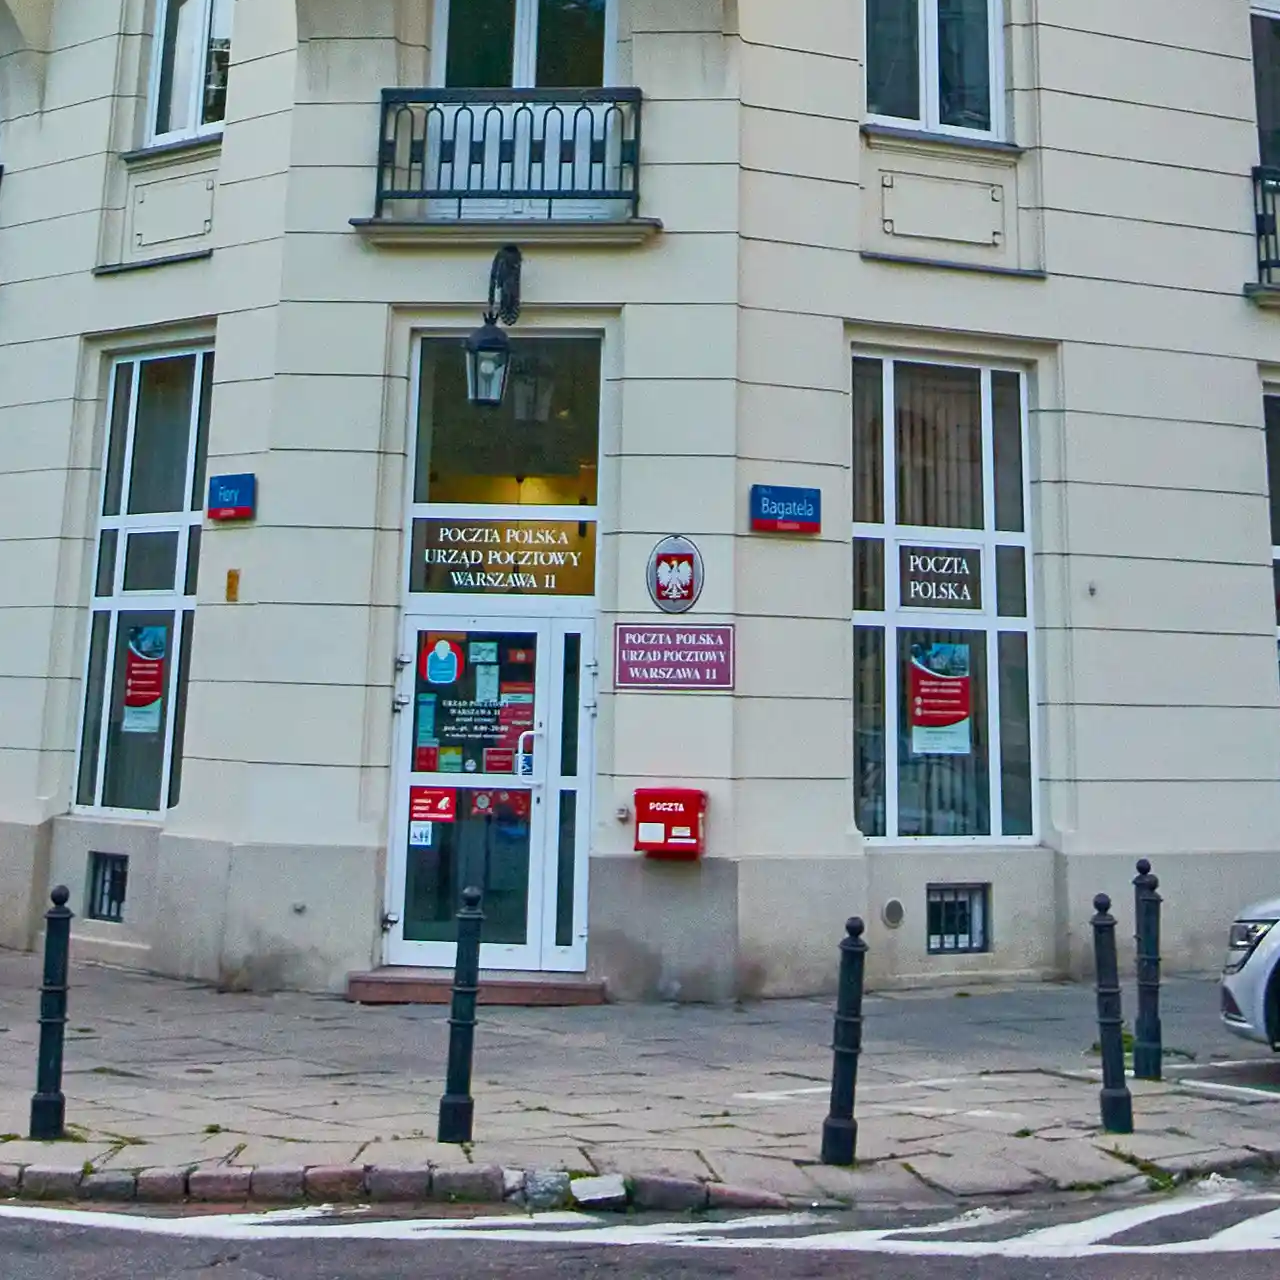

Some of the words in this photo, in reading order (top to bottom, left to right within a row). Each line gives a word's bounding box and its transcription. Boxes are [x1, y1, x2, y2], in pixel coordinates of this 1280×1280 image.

[761, 497, 814, 520] Bagatela
[438, 527, 501, 544] POCZTA
[505, 528, 569, 545] POLSKA
[424, 549, 483, 569] URZĄD
[487, 550, 582, 567] POCZTOWY
[909, 555, 970, 574] POCZTA
[450, 571, 537, 589] WARSZAWA
[544, 574, 556, 589] 11
[910, 581, 971, 600] POLSKA
[625, 633, 672, 645] POCZTA
[676, 633, 724, 645] POLSKA
[621, 649, 661, 663] URZĄD
[663, 650, 726, 663] POCZTOWY
[629, 667, 701, 680] WARSZAWA
[705, 668, 717, 680] 11
[649, 802, 684, 812] POCZTA
